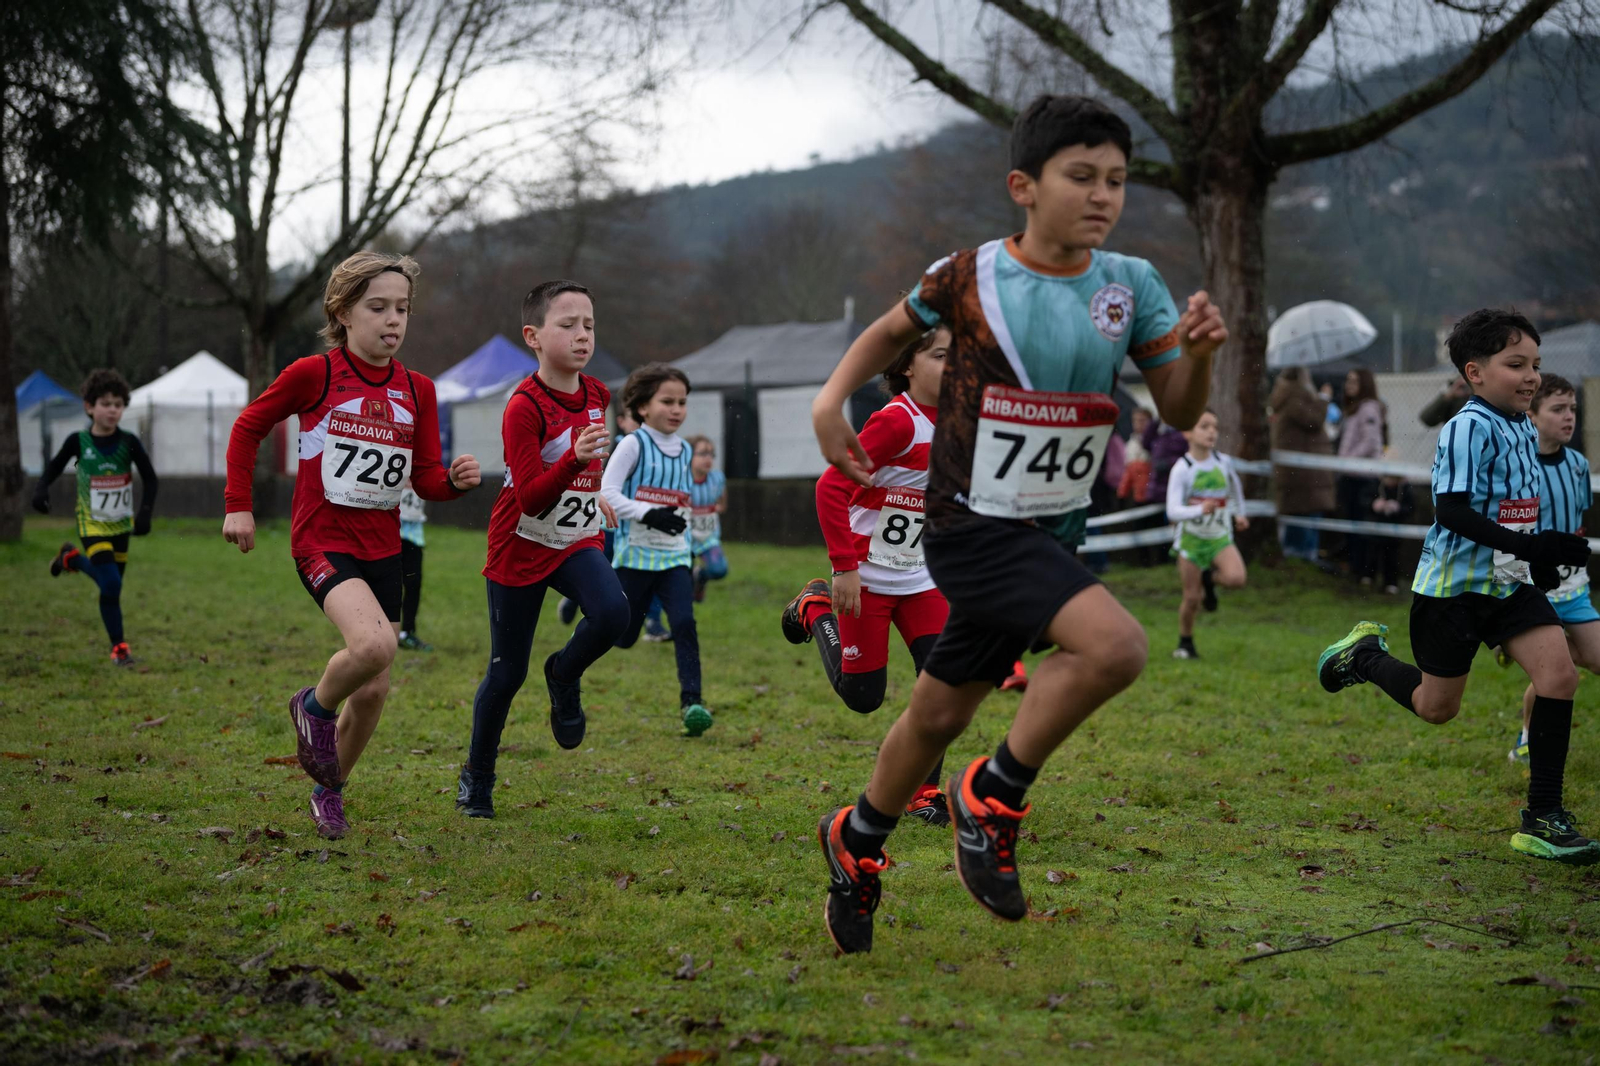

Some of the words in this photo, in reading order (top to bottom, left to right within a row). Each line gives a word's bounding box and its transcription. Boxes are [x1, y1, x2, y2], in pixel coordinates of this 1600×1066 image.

[348, 414, 375, 425] Memorial
[983, 397, 1078, 422] RIBADAVIA
[330, 419, 394, 441] RIBADAVIA
[334, 442, 407, 487] 728
[993, 430, 1094, 482] 746
[635, 490, 679, 503] RIBADAVIA
[885, 494, 927, 509] RIBADA
[822, 620, 840, 647] INOVIX
